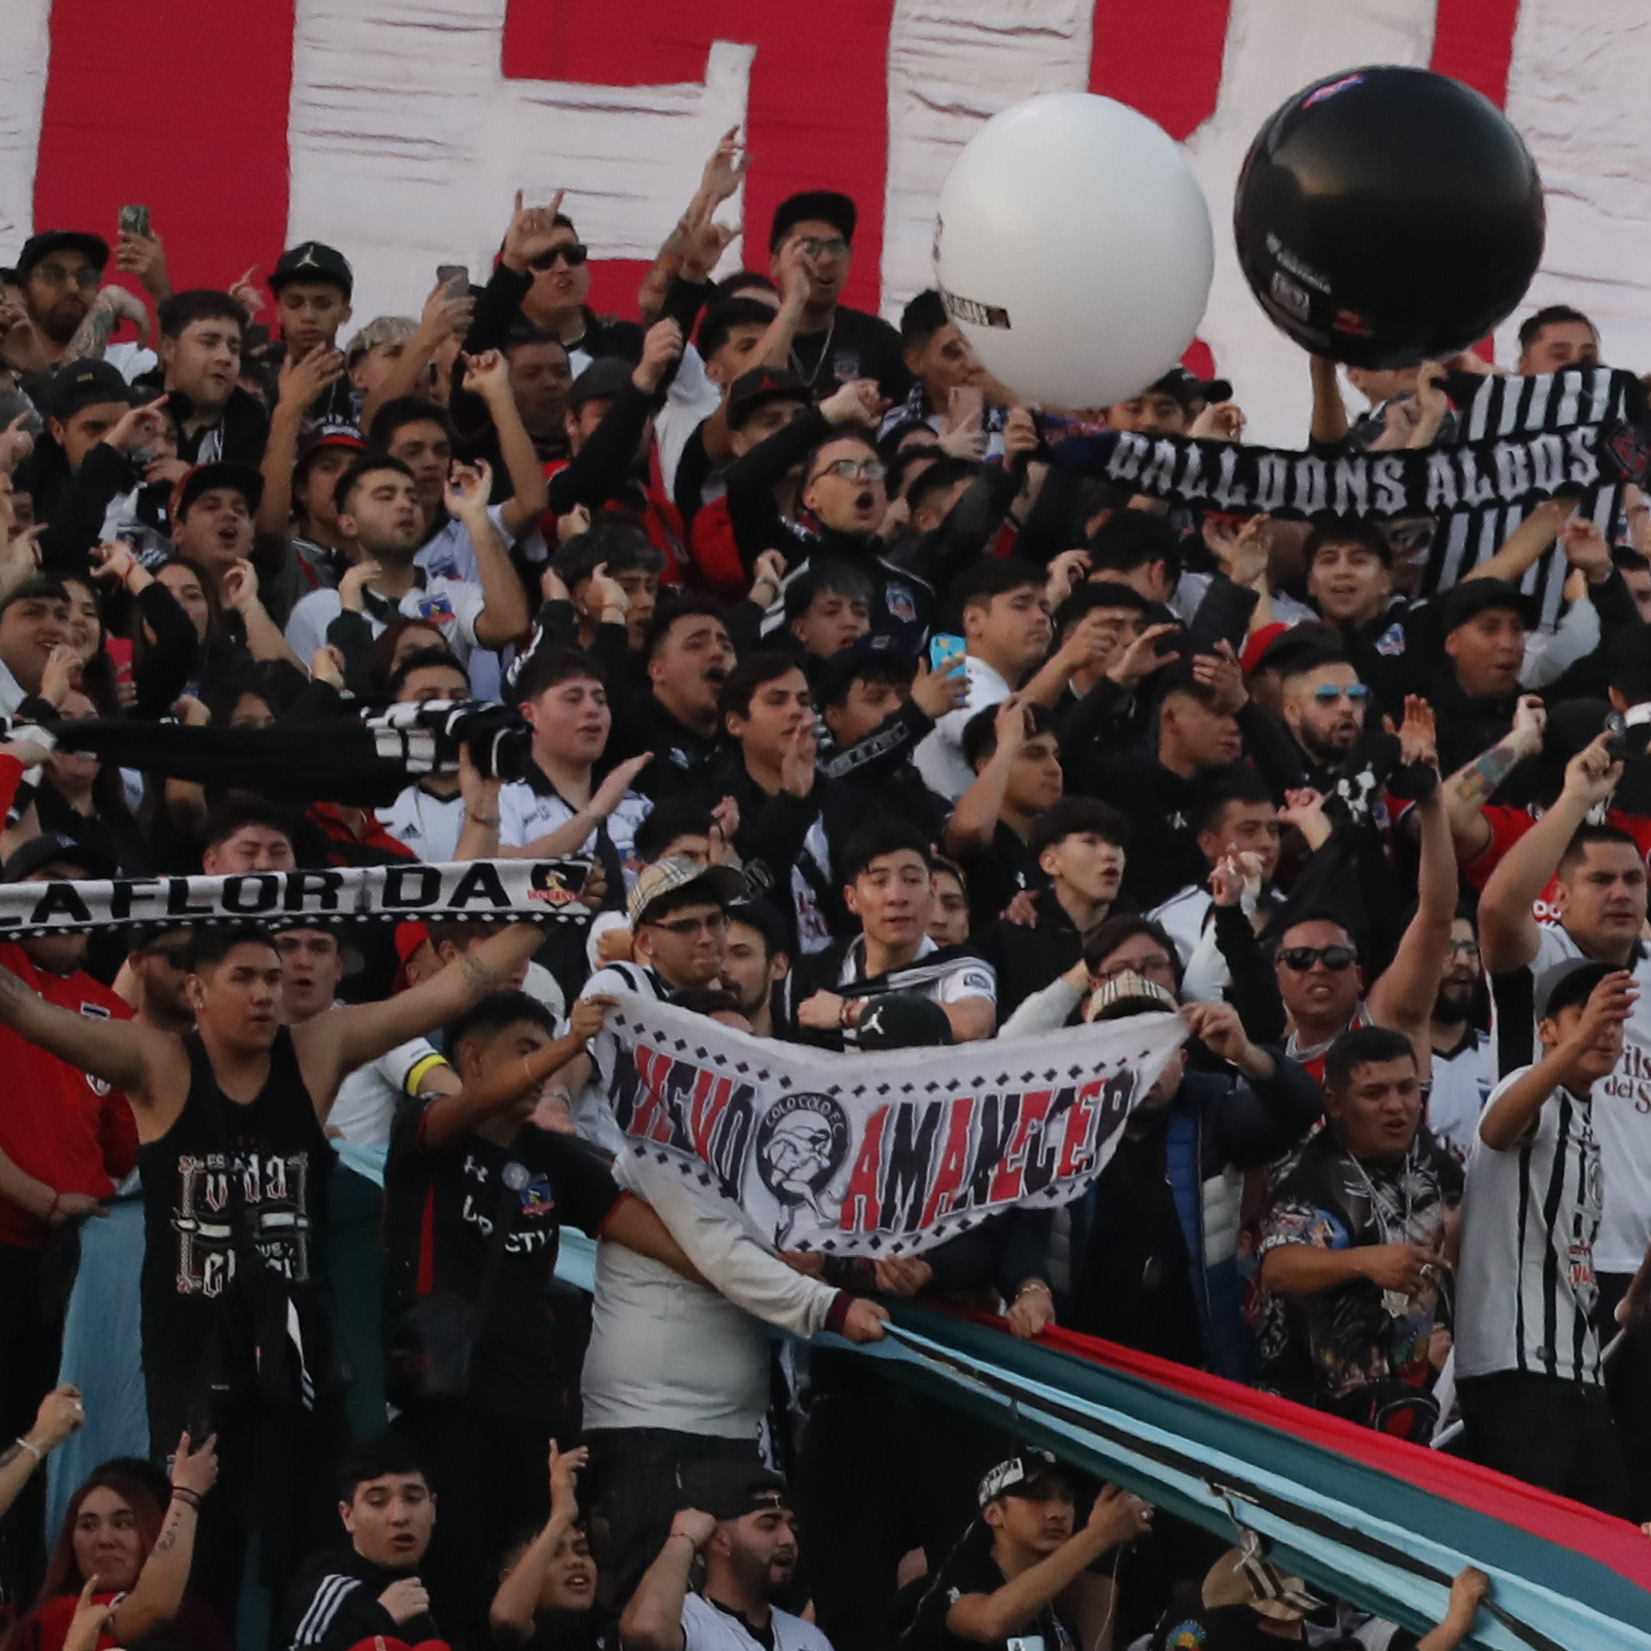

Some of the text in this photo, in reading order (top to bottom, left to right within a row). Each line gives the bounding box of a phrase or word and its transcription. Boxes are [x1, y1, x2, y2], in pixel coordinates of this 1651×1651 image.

[1106, 424, 1600, 518] BALLOONS ALBOS
[0, 858, 513, 923] A FLORDA
[766, 1097, 797, 1128] COLO
[1604, 1079, 1634, 1099] del
[838, 1068, 1137, 1232] AMANECER
